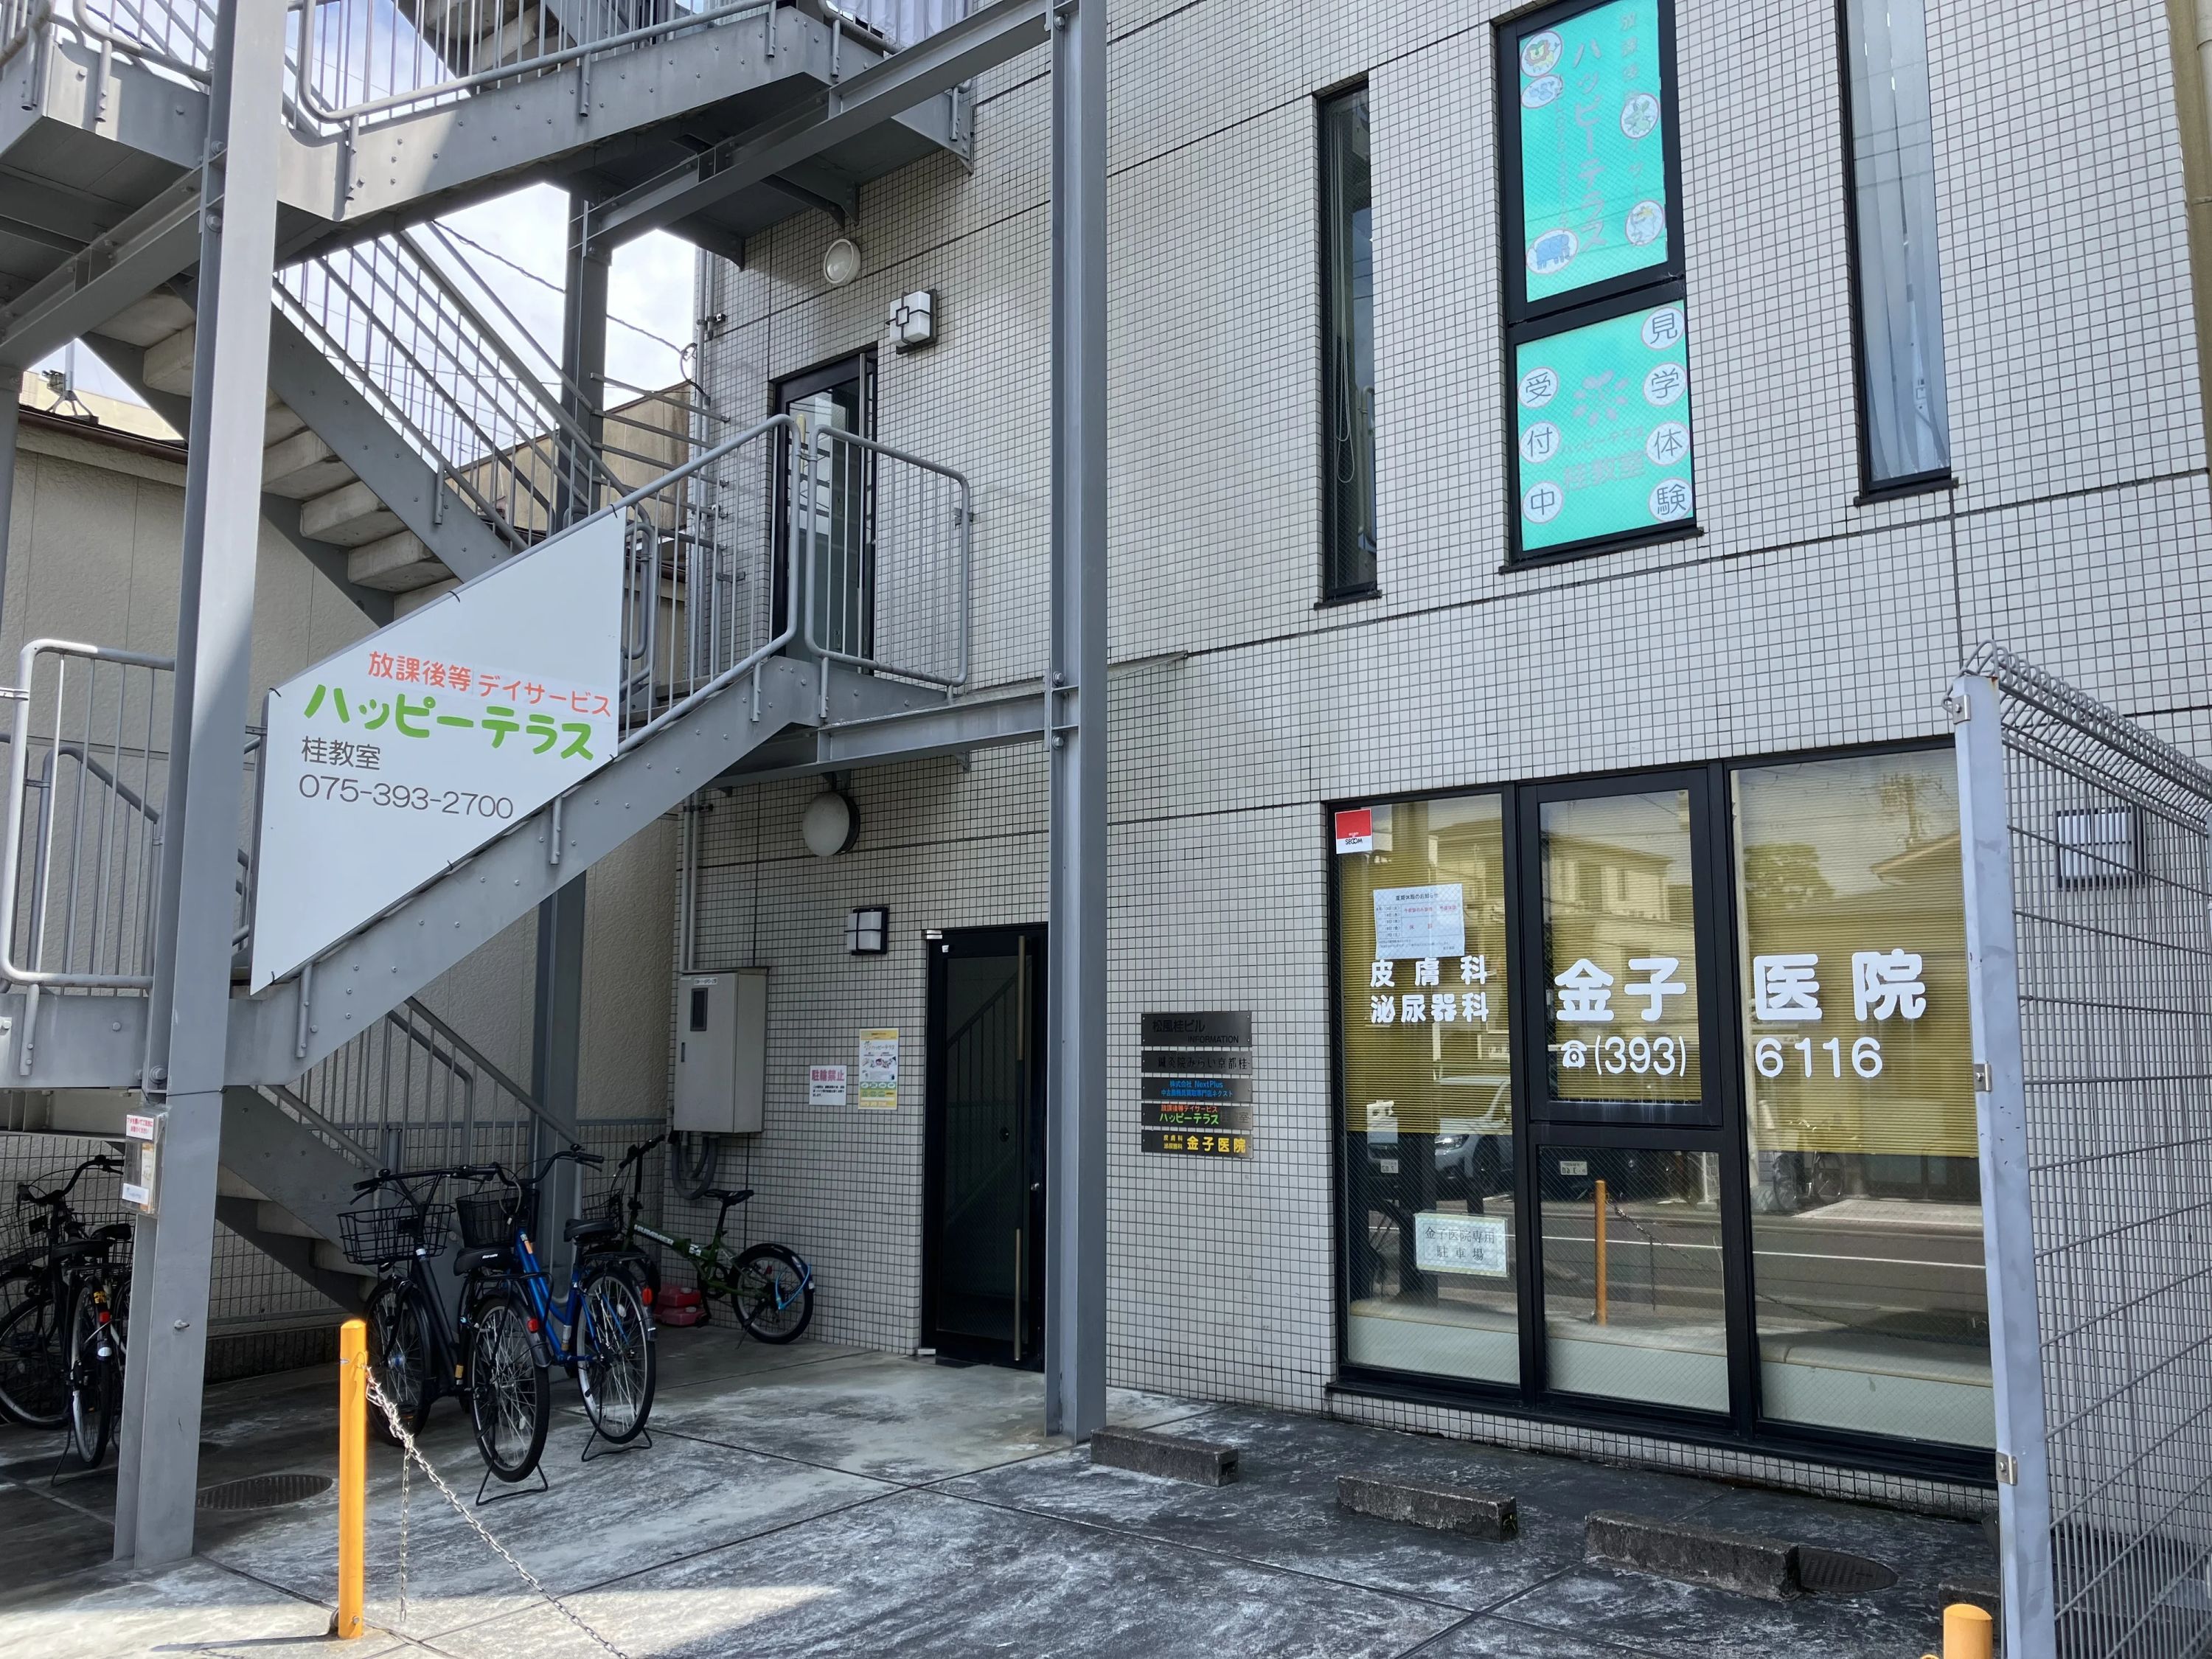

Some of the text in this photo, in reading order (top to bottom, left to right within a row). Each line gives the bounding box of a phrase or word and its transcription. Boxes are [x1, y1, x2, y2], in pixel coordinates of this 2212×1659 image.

[1651, 313, 1686, 515] 見学体験
[1526, 372, 1555, 515] 受付中
[304, 684, 594, 761] ハッピーテラス
[301, 736, 380, 771] 桂教室
[299, 773, 514, 819] 075-393-2700
[1370, 955, 1487, 987] 皮膚科
[1371, 992, 1489, 1023] 泌尿器科
[1187, 1035, 1239, 1043] INFORMATION
[1755, 1037, 1883, 1078] 6116
[812, 1069, 845, 1081] 駐輪禁止
[1159, 1113, 1220, 1125] ハッピーテラス
[1187, 1135, 1246, 1153] 金子医院
[1425, 1226, 1495, 1244] 金子医院専用
[1436, 1245, 1484, 1262] 駐車場
